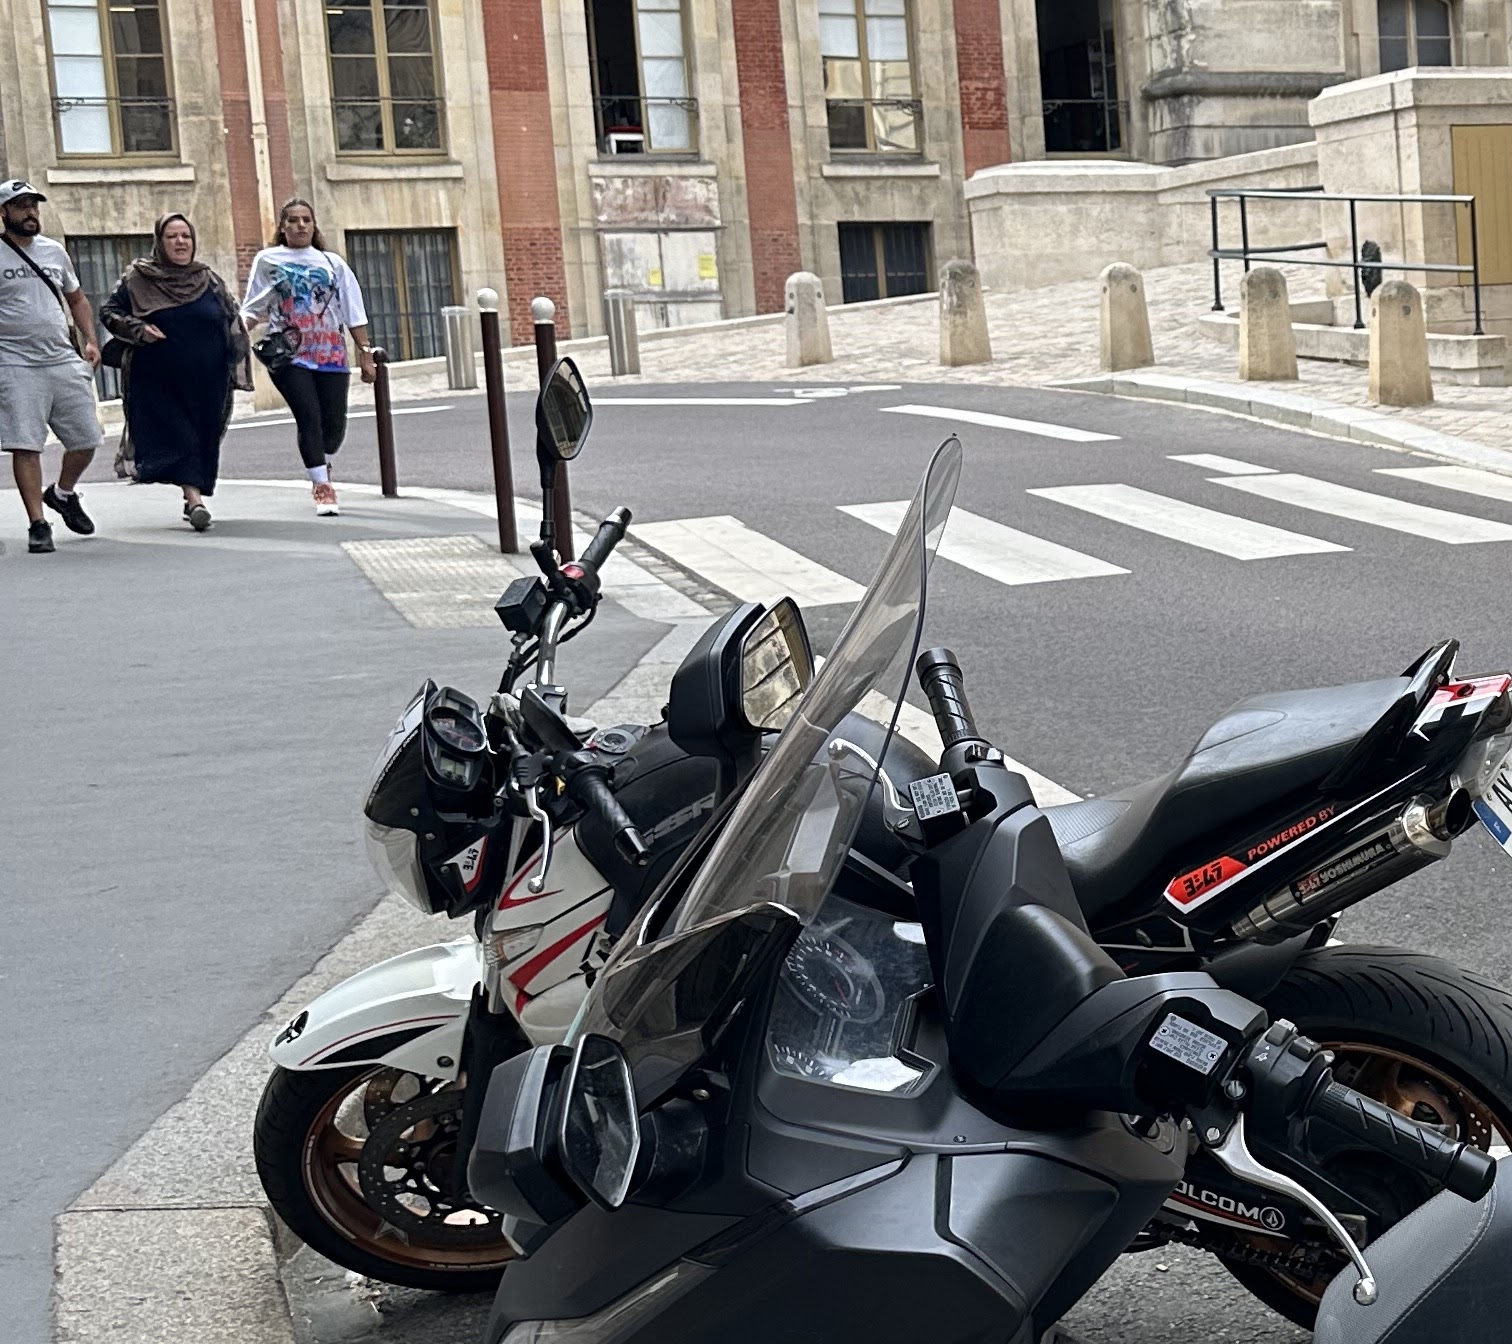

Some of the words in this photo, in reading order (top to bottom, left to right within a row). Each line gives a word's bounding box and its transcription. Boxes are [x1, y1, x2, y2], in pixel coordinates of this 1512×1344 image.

[1247, 816, 1316, 861] POWERED
[1318, 805, 1336, 822] BY
[1320, 844, 1385, 883] YOSHIMURA
[1174, 1181, 1259, 1219] OLCOM
